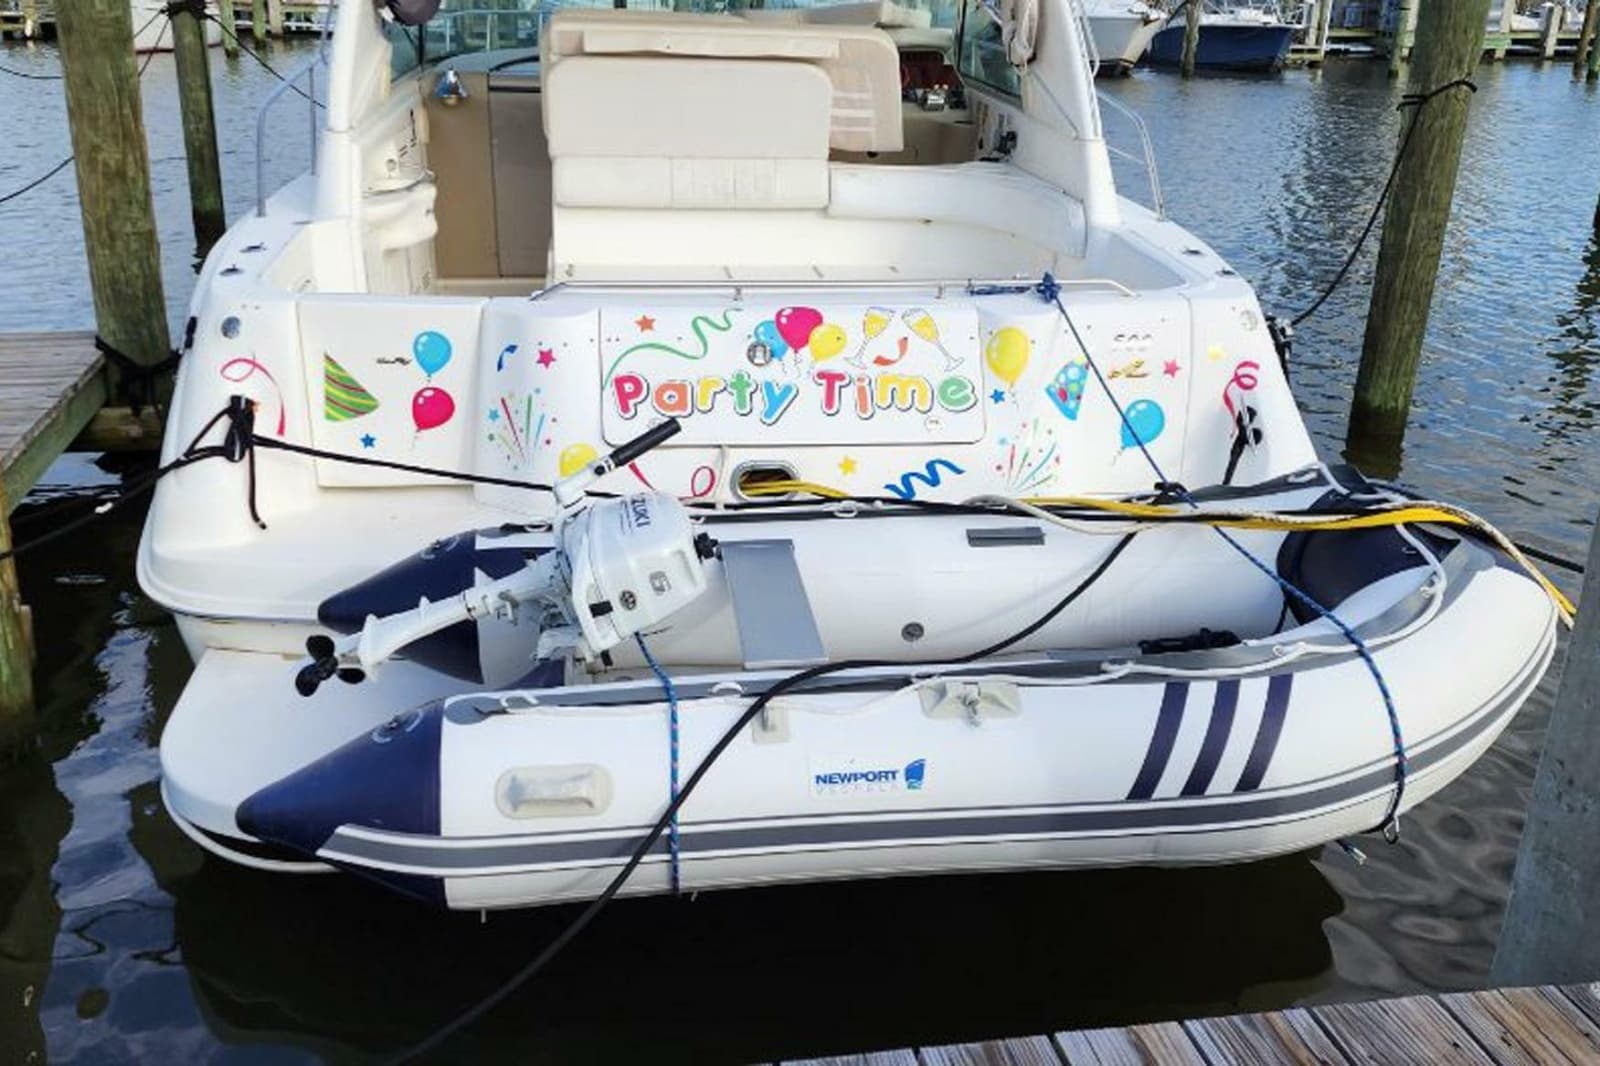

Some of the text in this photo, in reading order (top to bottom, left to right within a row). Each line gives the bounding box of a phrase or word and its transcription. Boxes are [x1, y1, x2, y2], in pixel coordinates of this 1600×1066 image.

[612, 370, 977, 426] Party Time
[815, 770, 898, 784] NEWPORT
